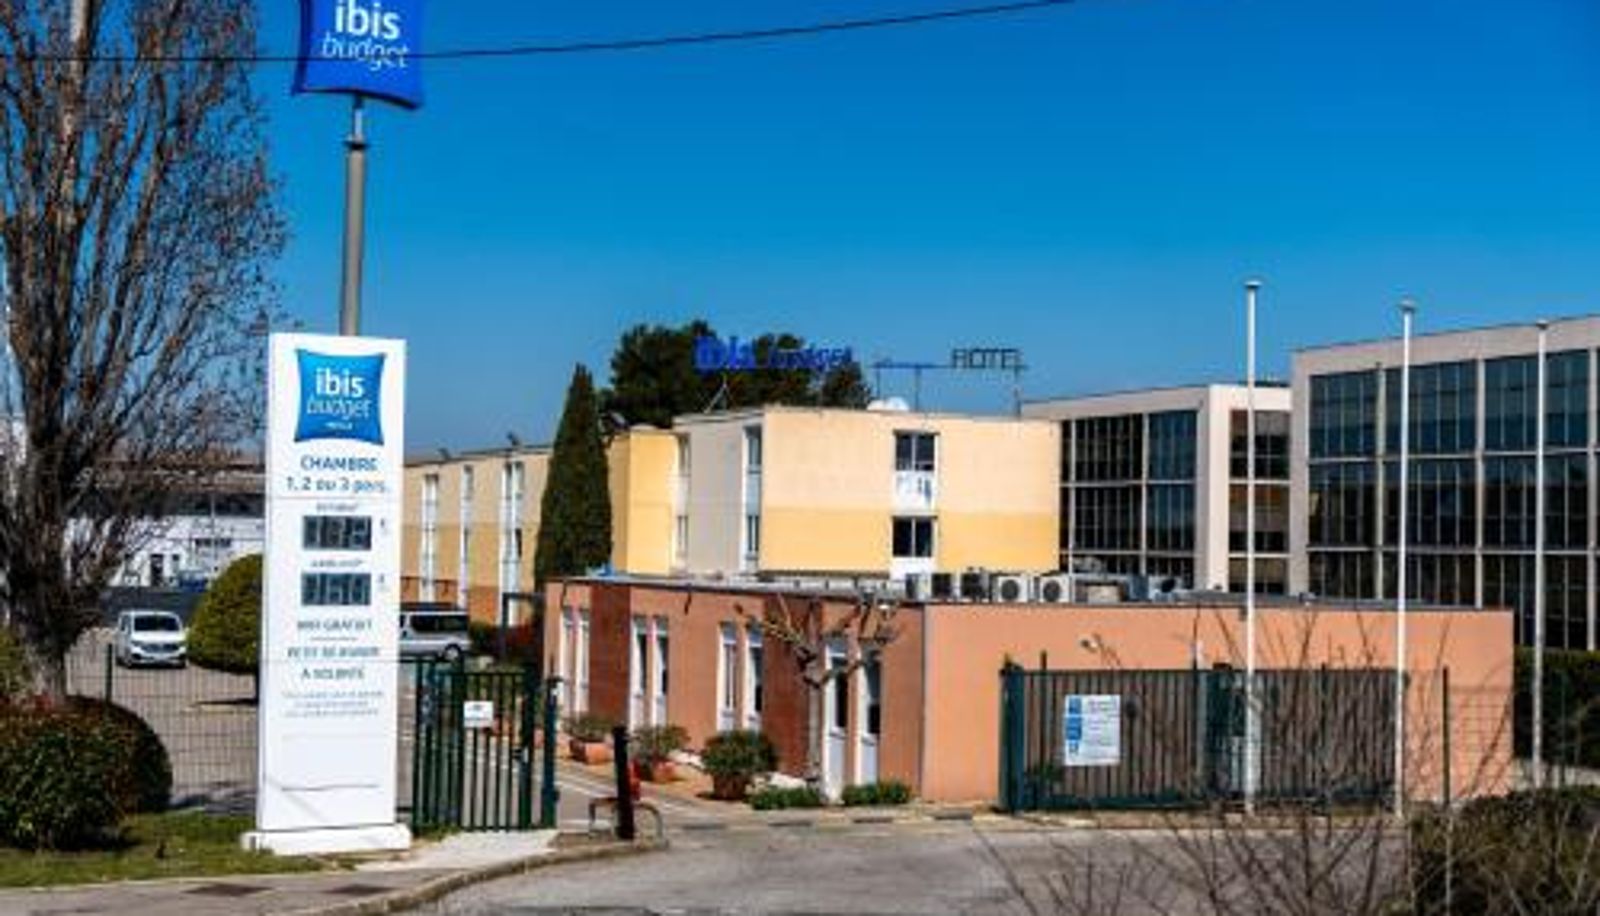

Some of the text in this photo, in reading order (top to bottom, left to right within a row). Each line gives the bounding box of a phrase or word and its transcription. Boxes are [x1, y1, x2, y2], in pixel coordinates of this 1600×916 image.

[335, 0, 400, 40] ibis
[322, 31, 409, 71] budget
[315, 367, 365, 398] ibis
[306, 393, 372, 420] budget
[299, 454, 379, 471] CHAMBRE
[301, 476, 312, 491] 2
